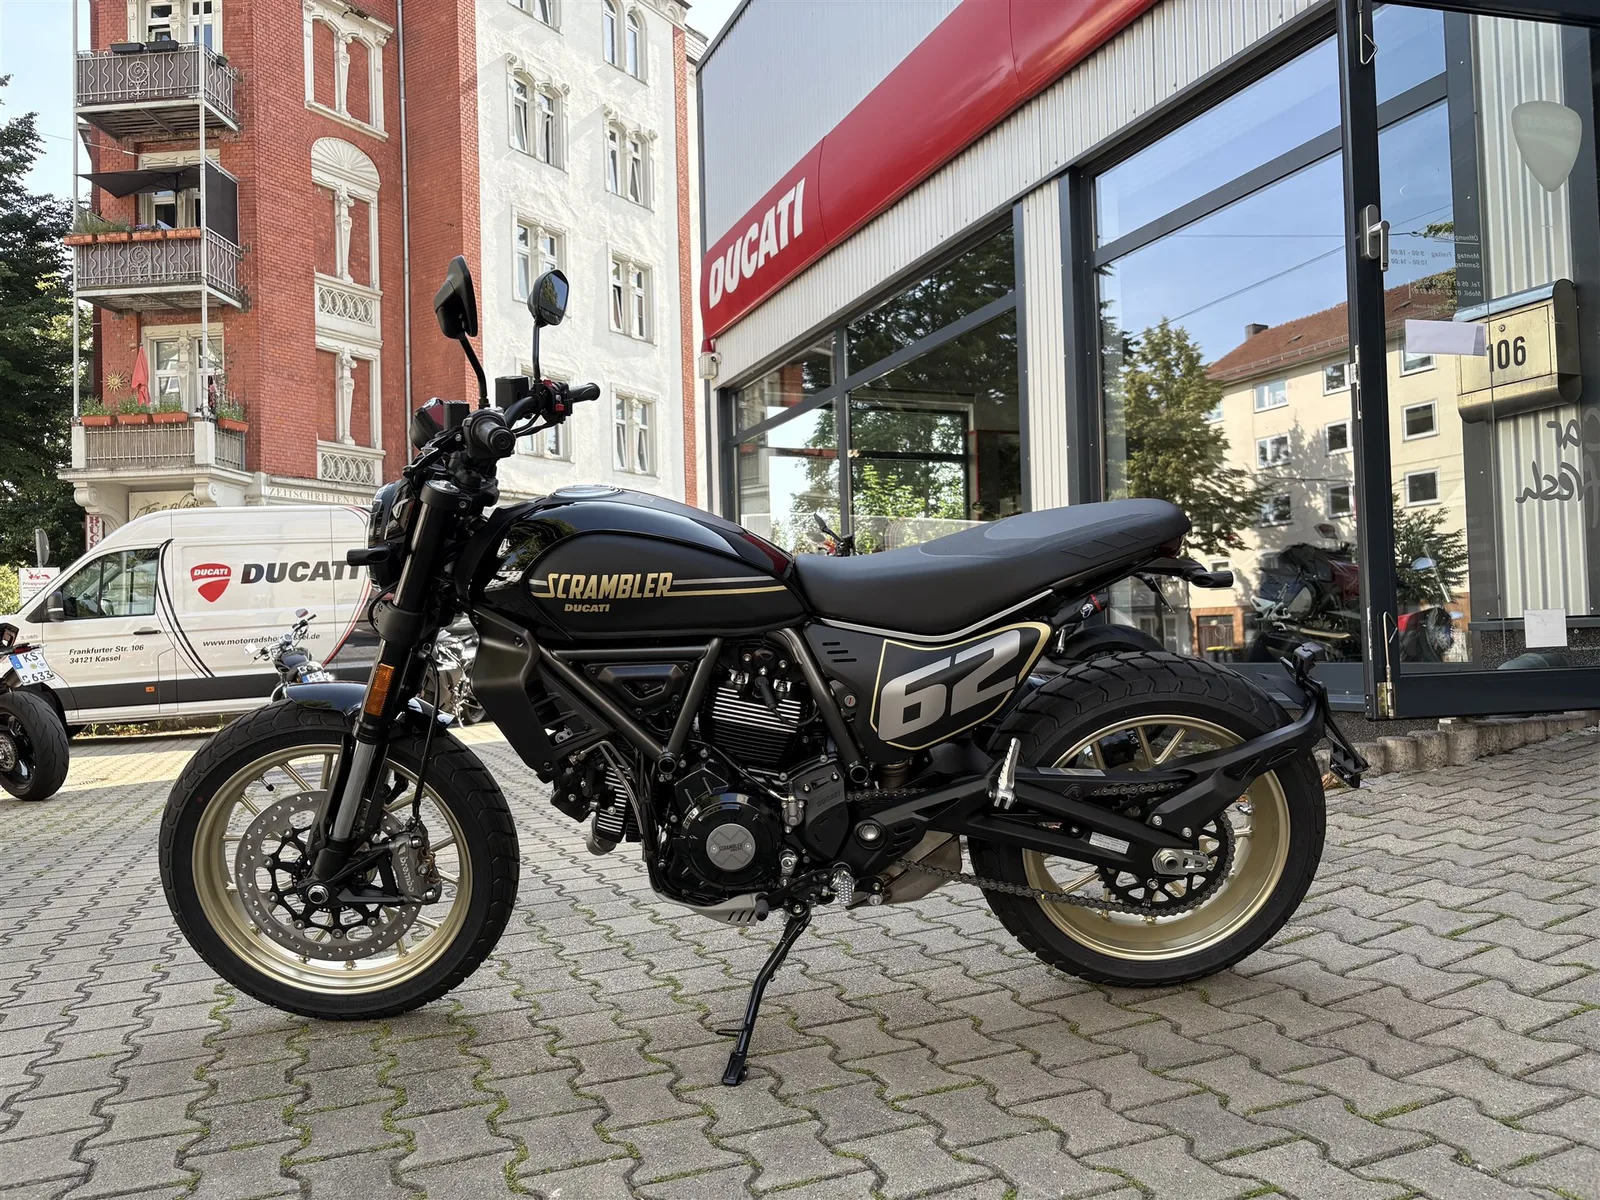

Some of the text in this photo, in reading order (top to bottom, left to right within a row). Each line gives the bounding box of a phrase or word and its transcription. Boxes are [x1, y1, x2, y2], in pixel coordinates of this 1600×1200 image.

[708, 177, 805, 309] DUCATI
[1488, 336, 1526, 372] 106
[193, 568, 228, 576] DUCATI
[241, 561, 359, 584] DUCATI
[547, 571, 673, 599] SCRAMBLER
[564, 603, 610, 613] DUCATI
[22, 651, 39, 663] KS
[69, 646, 113, 656] Frankfurter
[69, 655, 121, 665] 34121 Kassel
[31, 670, 54, 682] 633
[878, 630, 1021, 741] 62
[400, 856, 414, 893] brembo
